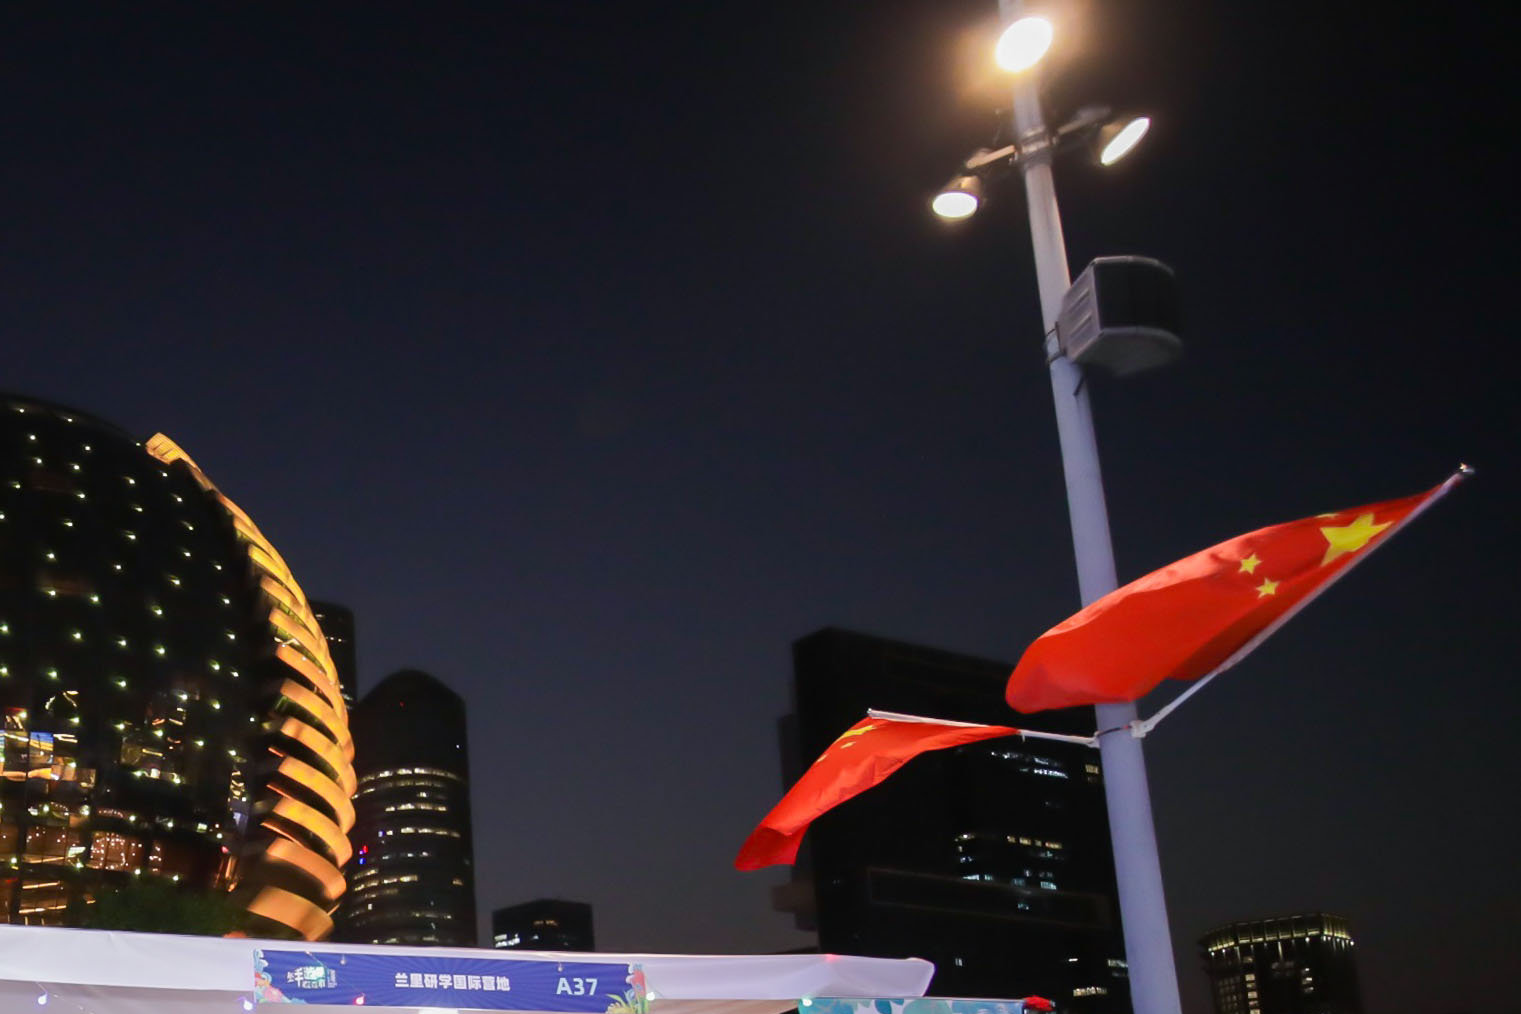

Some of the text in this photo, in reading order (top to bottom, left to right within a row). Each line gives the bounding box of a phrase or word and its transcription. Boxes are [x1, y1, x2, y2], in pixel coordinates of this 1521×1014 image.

[395, 973, 598, 996] 兰里研学国际营地 A37
